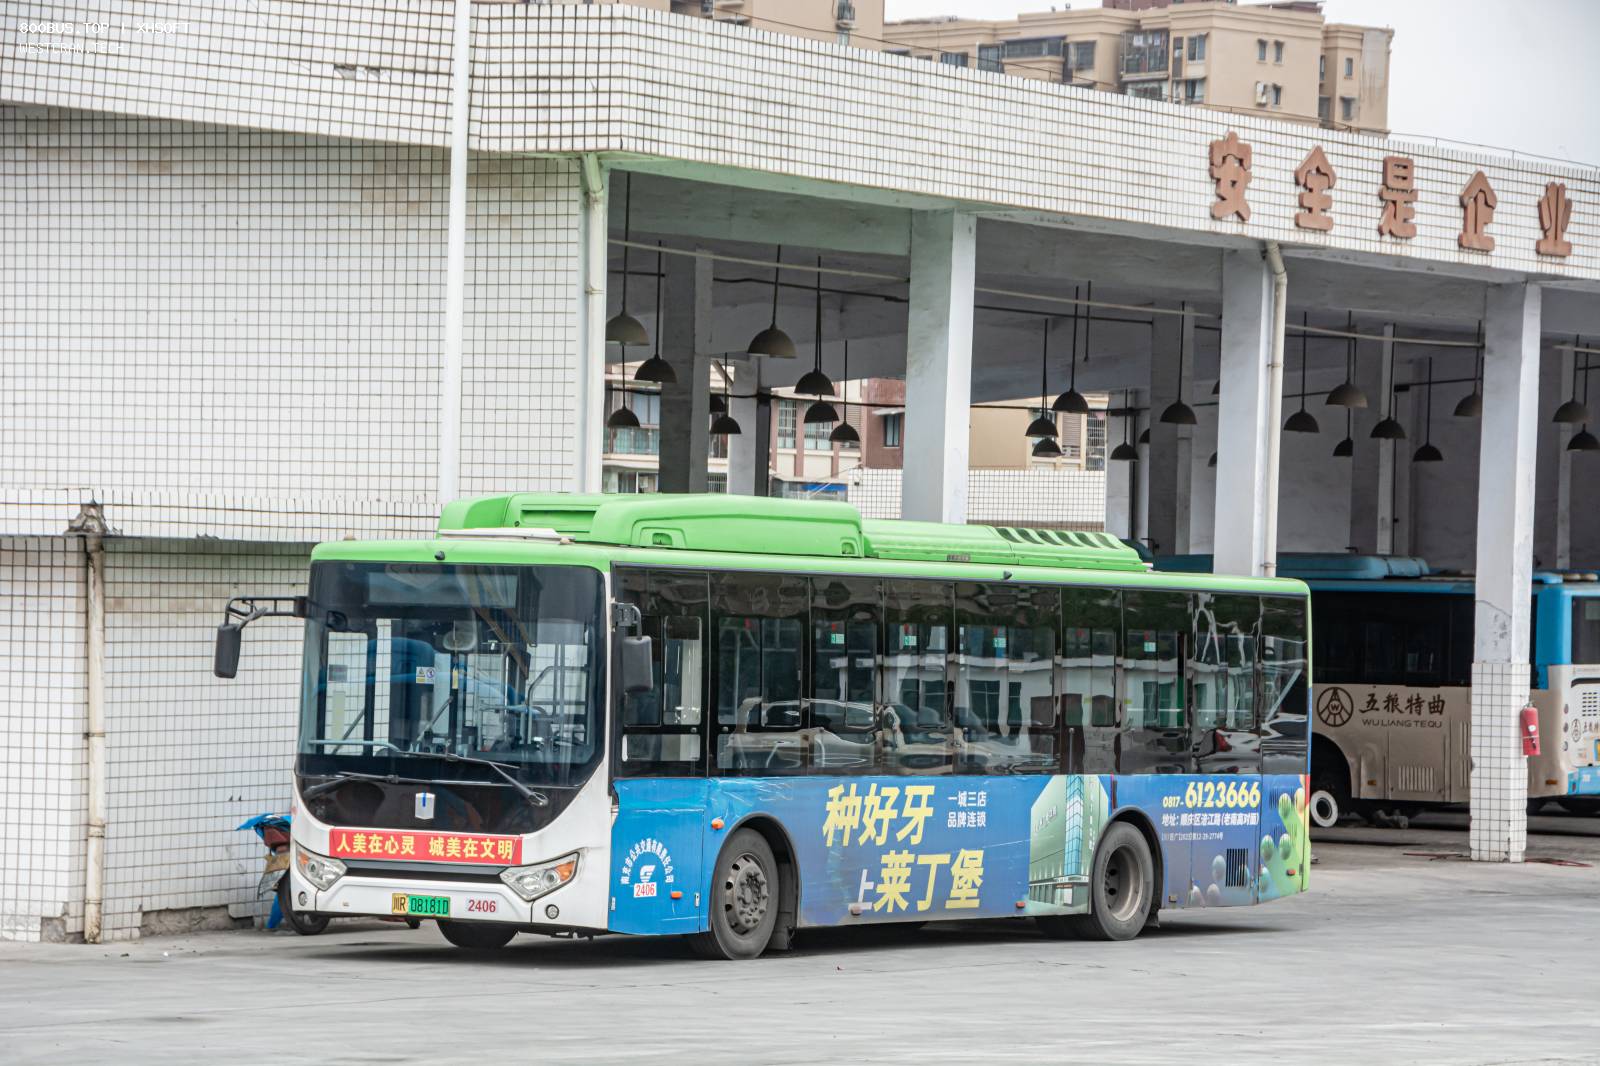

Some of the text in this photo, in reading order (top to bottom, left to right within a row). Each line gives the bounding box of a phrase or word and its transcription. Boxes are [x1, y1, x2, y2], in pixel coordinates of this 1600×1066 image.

[1209, 130, 1573, 258] 安全是企业
[1359, 691, 1445, 716] 五粮特曲
[947, 791, 987, 807] 一城三店
[822, 783, 935, 847] 种好牙
[947, 811, 987, 828] 品牌连锁
[336, 832, 514, 861] 人美在心灵 城美在文明
[635, 883, 655, 897] 2406
[468, 899, 497, 913] 2406
